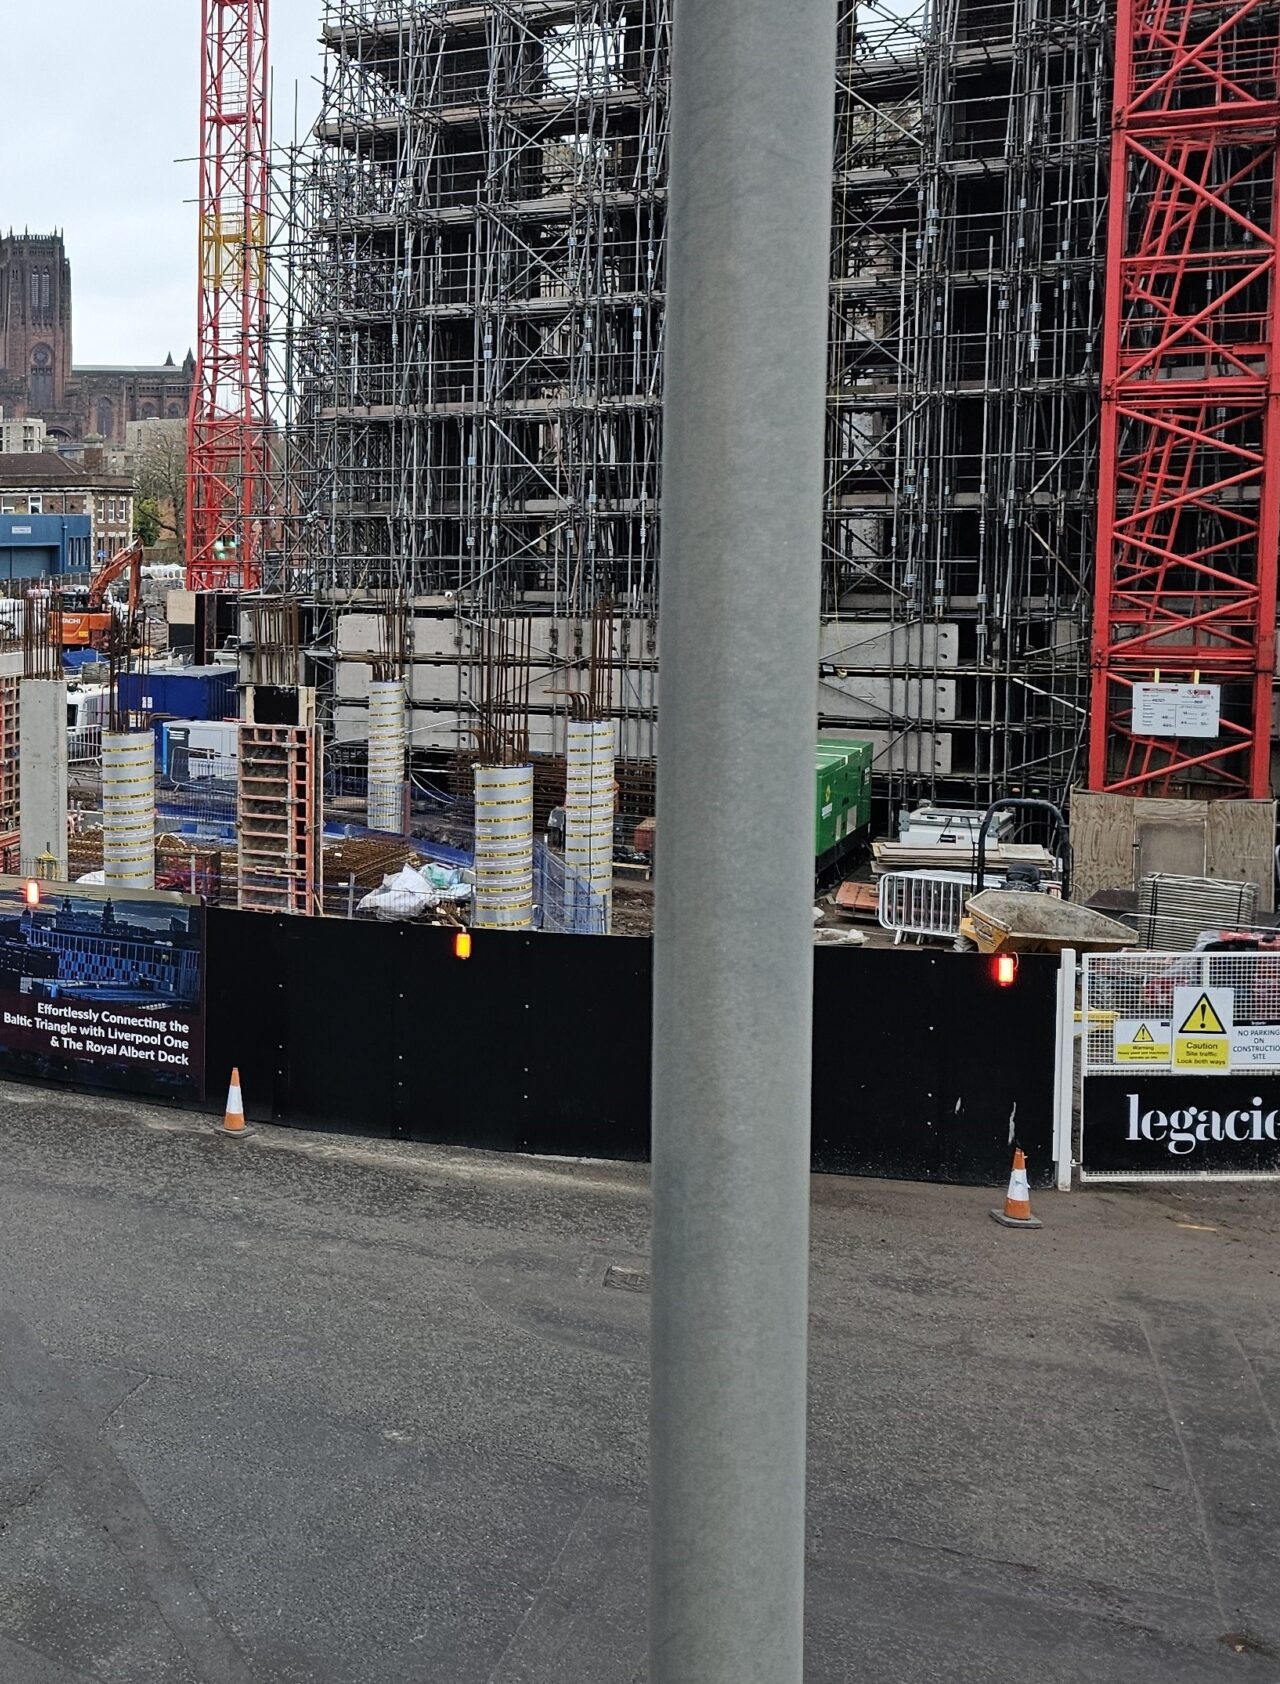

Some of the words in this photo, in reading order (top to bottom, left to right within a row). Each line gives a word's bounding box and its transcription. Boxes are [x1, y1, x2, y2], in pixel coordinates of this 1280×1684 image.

[3, 1012, 33, 1027] Baltic
[34, 1017, 77, 1035] Triangle
[79, 1025, 105, 1038] with
[108, 1027, 161, 1045] Liverpool
[163, 1035, 189, 1049] One
[37, 1002, 99, 1022] Effortlessly
[101, 1011, 167, 1032] Connecting
[169, 1020, 190, 1034] the
[50, 1036, 60, 1048] &
[61, 1037, 83, 1050] The
[86, 1040, 117, 1055] Royal
[118, 1045, 155, 1060] Albert
[158, 1050, 189, 1066] Dock
[1186, 1041, 1218, 1050] Caution
[1233, 1045, 1280, 1053] CONSTRUCTIO
[1125, 1093, 1280, 1155] legacie
